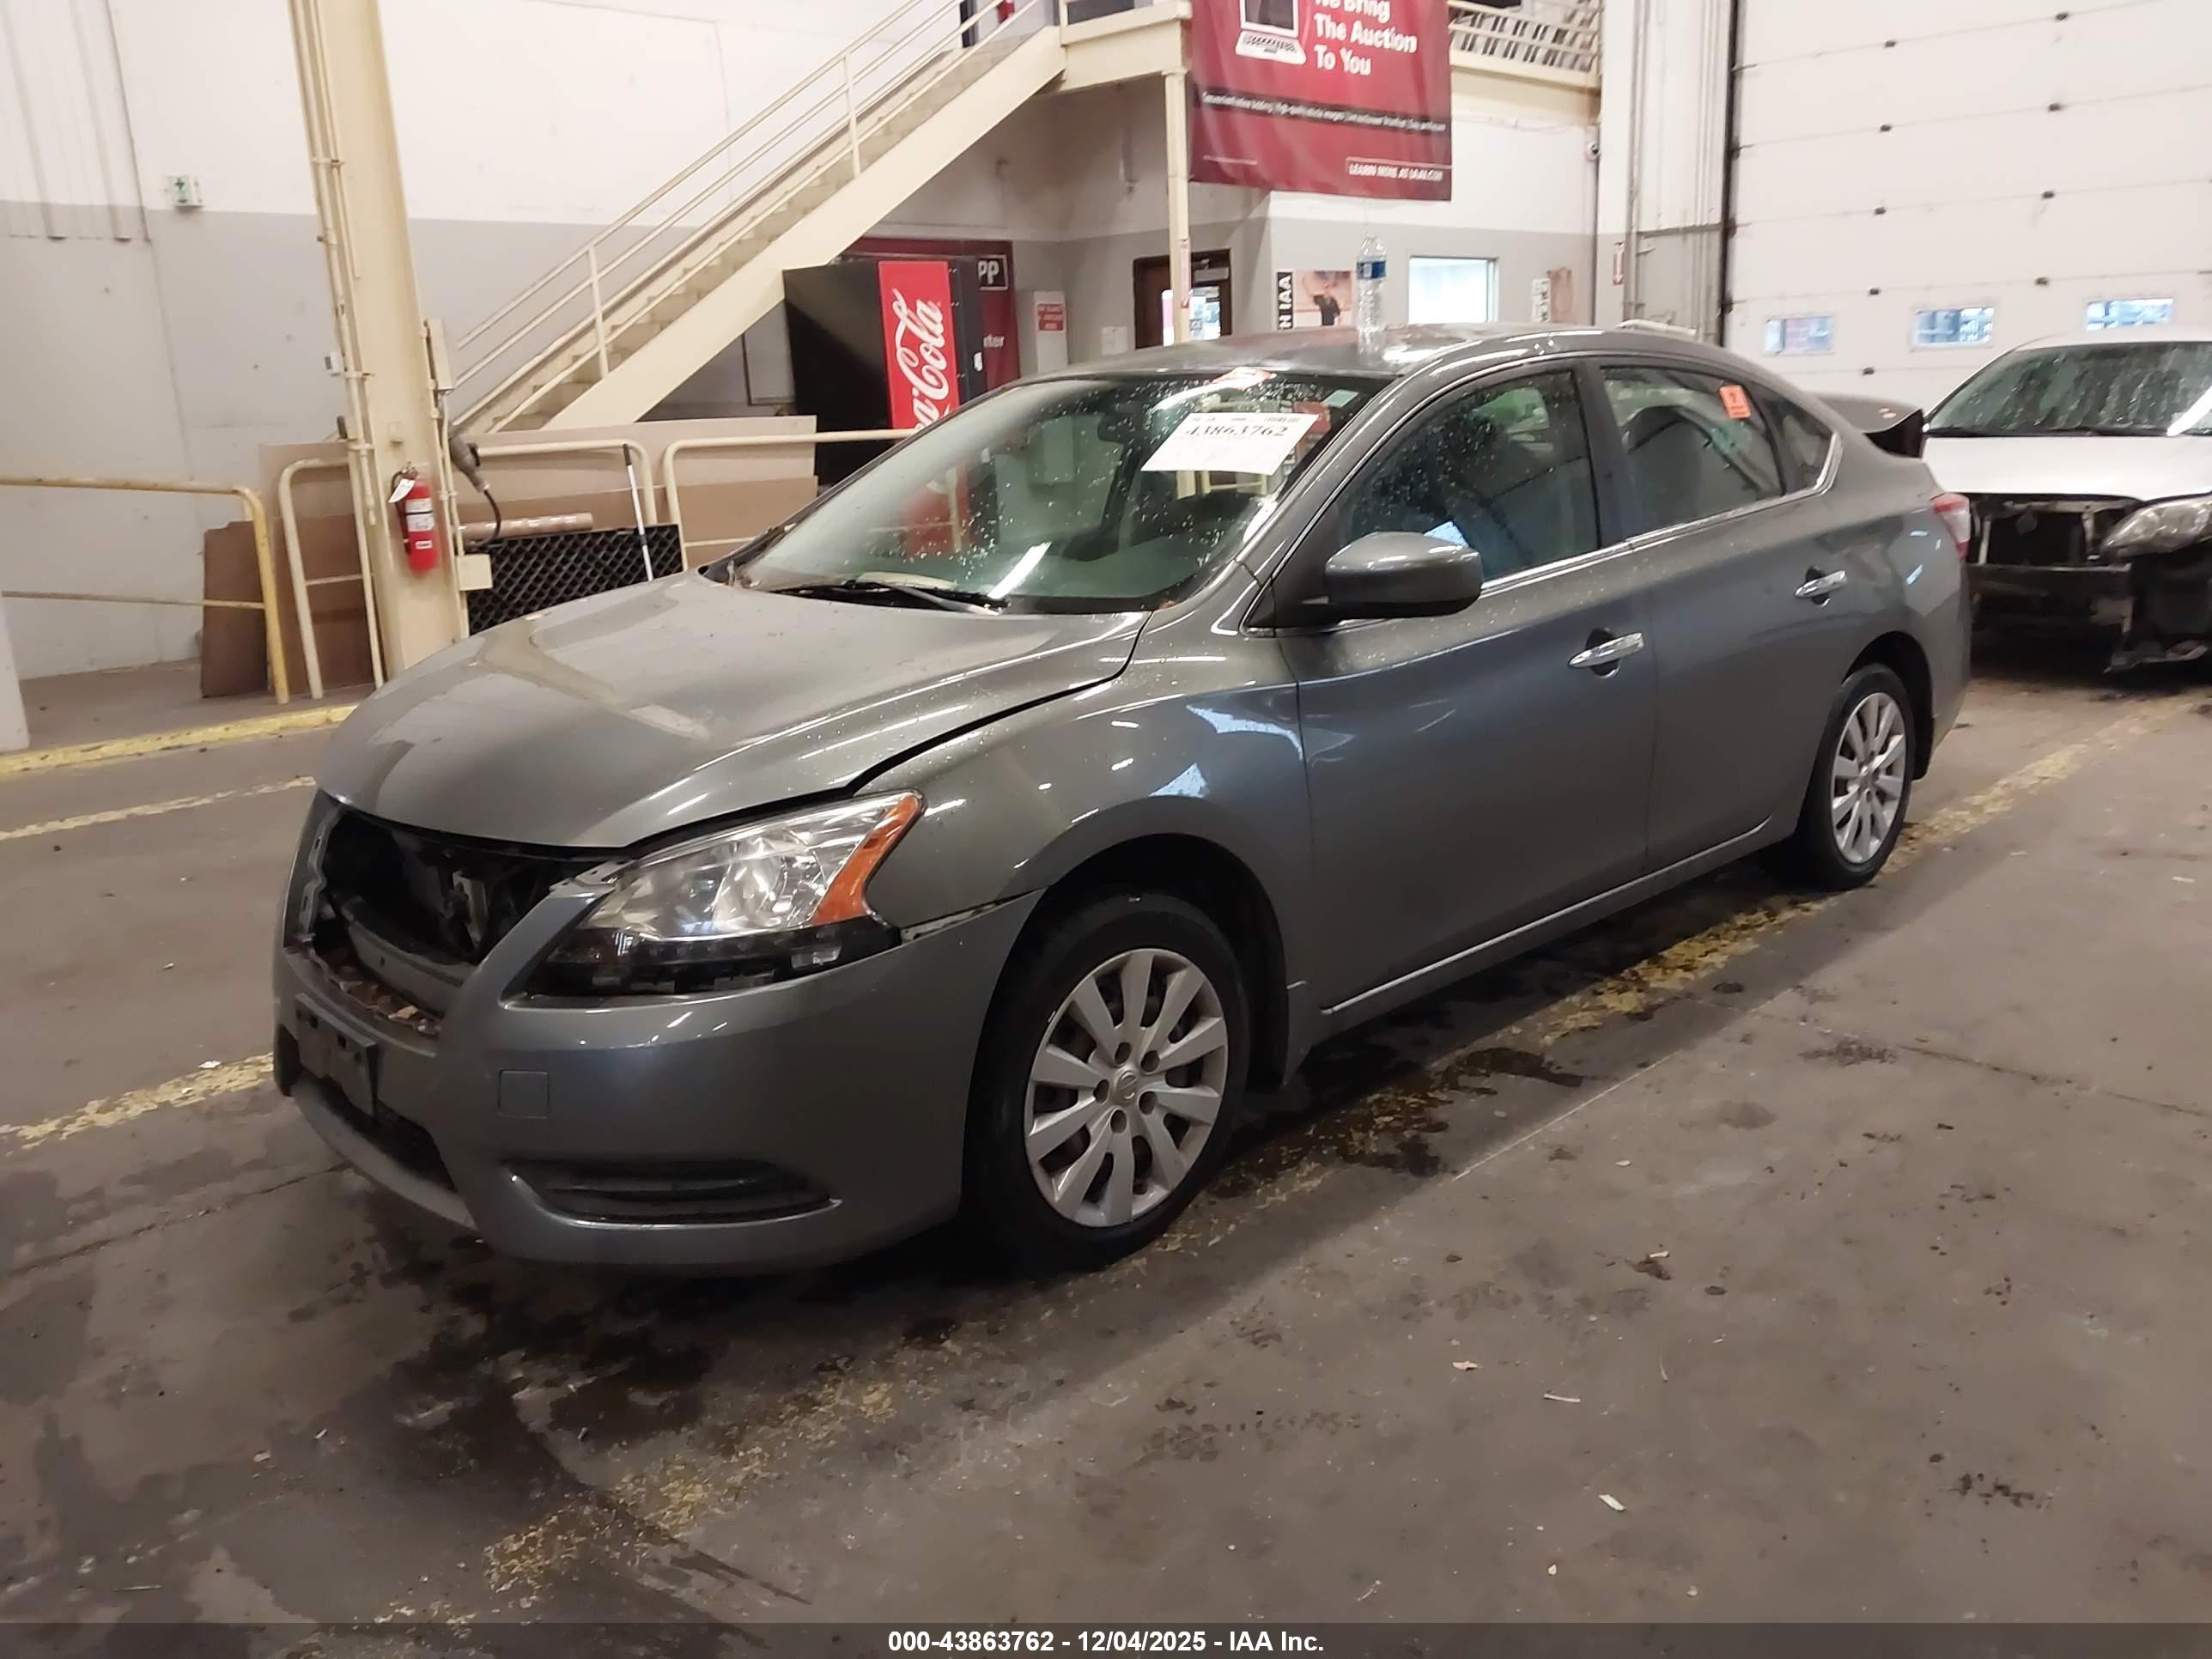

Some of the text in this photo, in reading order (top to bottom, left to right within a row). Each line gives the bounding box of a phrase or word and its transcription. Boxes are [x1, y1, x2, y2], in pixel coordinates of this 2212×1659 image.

[1314, 12, 1418, 53] The Auction
[1314, 44, 1371, 76] To You
